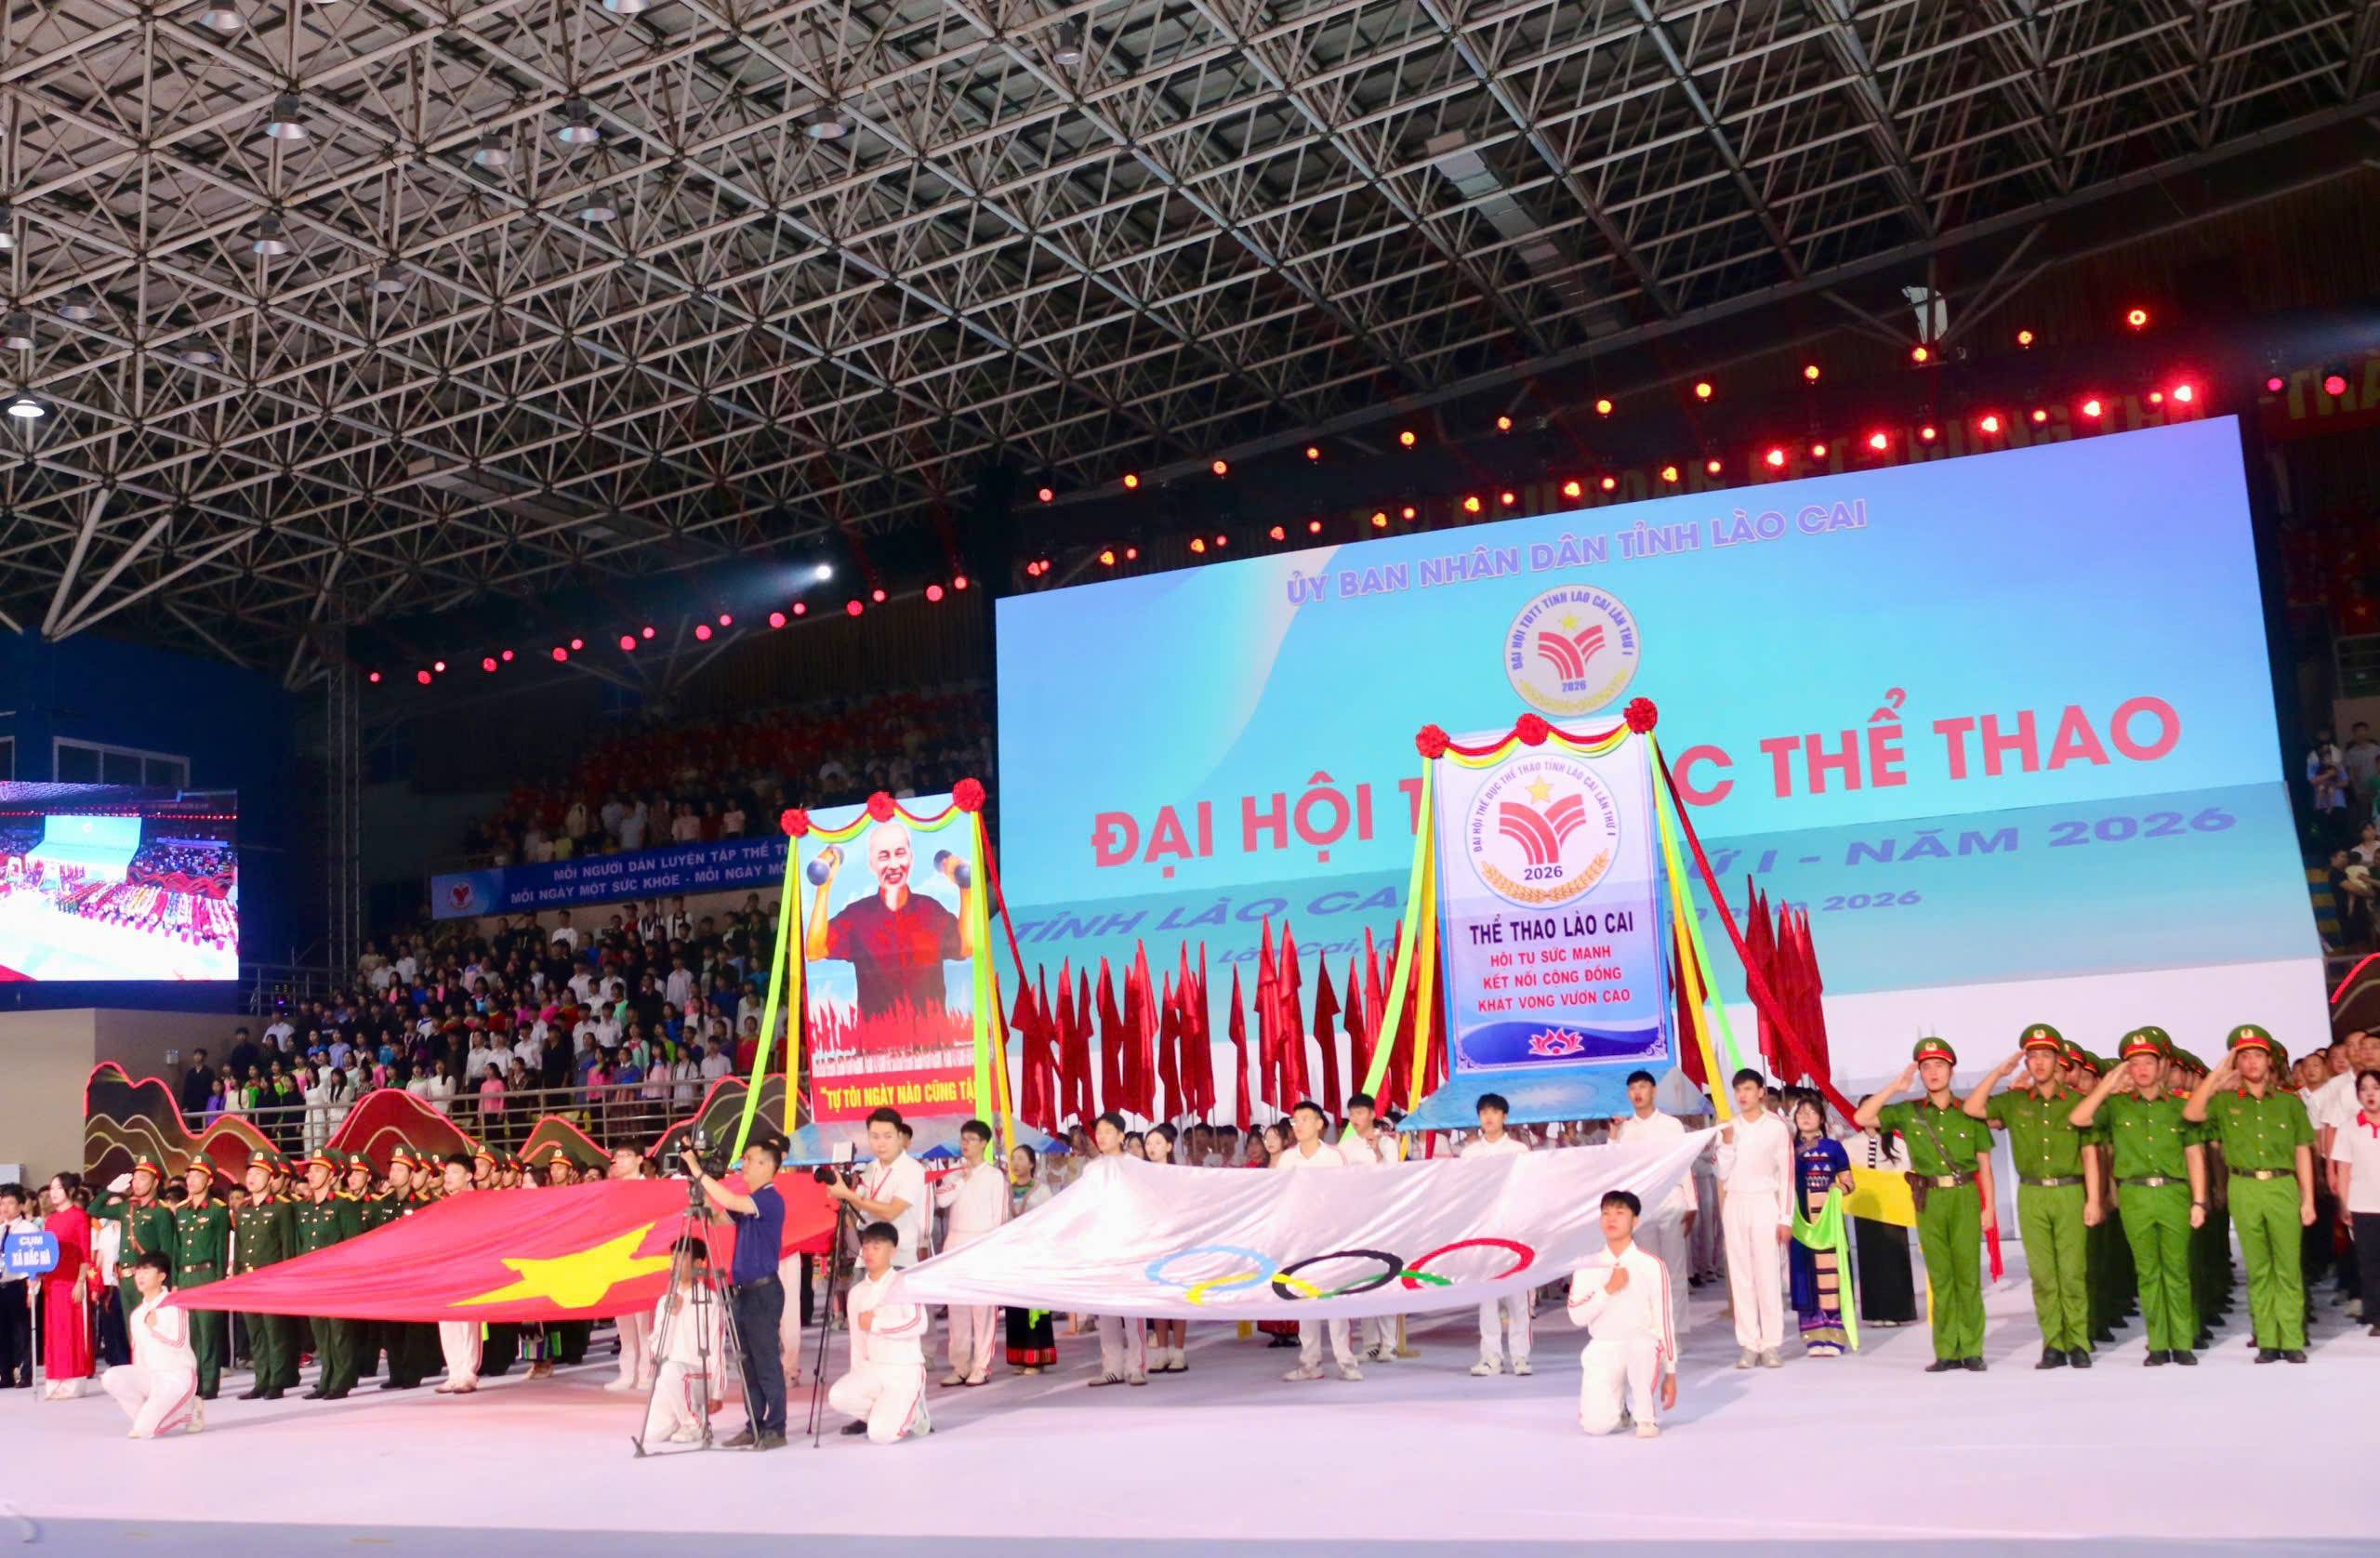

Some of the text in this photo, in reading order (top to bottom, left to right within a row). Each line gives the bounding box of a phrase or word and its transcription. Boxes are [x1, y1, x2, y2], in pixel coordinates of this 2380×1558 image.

[1287, 498, 1869, 604] ỦY BAN NHÂN DÂN TỈNH LÀO CAI
[1593, 595, 1610, 611] CAI
[1562, 680, 1586, 693] 2026
[1760, 687, 1908, 799] THỂ
[1933, 695, 2181, 780] THAO
[1091, 800, 1212, 878] ĐẠI
[1241, 772, 1373, 865] HỘI
[1845, 827, 2018, 866] NĂM
[2049, 805, 2237, 849] 2026
[1524, 865, 1563, 880] 2026
[1009, 886, 1408, 944] TỈNH LÀO CA
[1822, 890, 1922, 912] 2026
[1470, 910, 1633, 944] THỂ THAO LÀO CAI
[1490, 951, 1513, 970] HỘI
[1540, 946, 1567, 963] SỨC
[1572, 945, 1611, 963] MẠNH
[1603, 989, 1631, 1003] CAO
[843, 1085, 862, 1109] TÔI
[864, 1082, 894, 1107] NGÀY
[897, 1080, 922, 1104] NÀO
[924, 1079, 957, 1102] CŨNG
